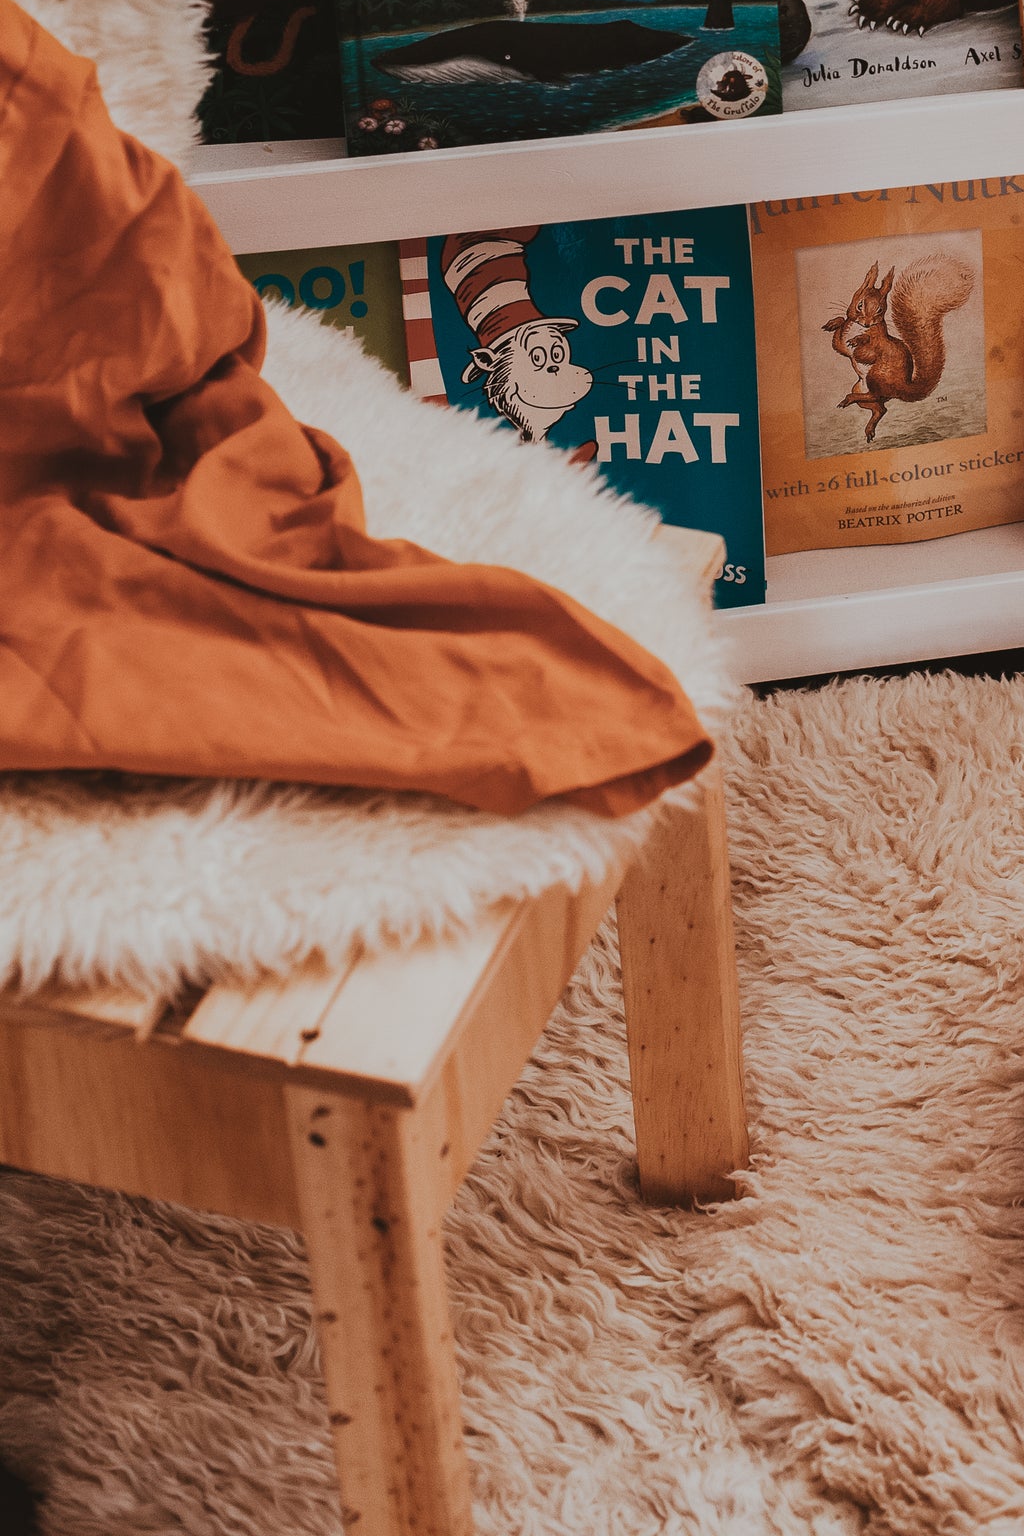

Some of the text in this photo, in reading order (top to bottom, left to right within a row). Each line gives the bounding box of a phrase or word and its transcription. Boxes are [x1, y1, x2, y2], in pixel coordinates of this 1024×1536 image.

[802, 64, 841, 88] Julia
[848, 56, 937, 79] Donaldson
[964, 46, 1002, 66] Axel
[707, 96, 760, 115] The Gruffalo
[614, 235, 694, 265] THE
[581, 273, 730, 326] CAT
[636, 335, 680, 363] IN
[618, 374, 700, 401] THE
[594, 410, 740, 464] HAT
[766, 480, 809, 500] with
[816, 478, 839, 493] 26
[845, 463, 954, 490] full-colour
[838, 504, 964, 530] BEATRIX POTTER
[845, 506, 867, 515] Based
[878, 503, 889, 511] the
[890, 497, 931, 510] authorized
[931, 494, 956, 504] edition
